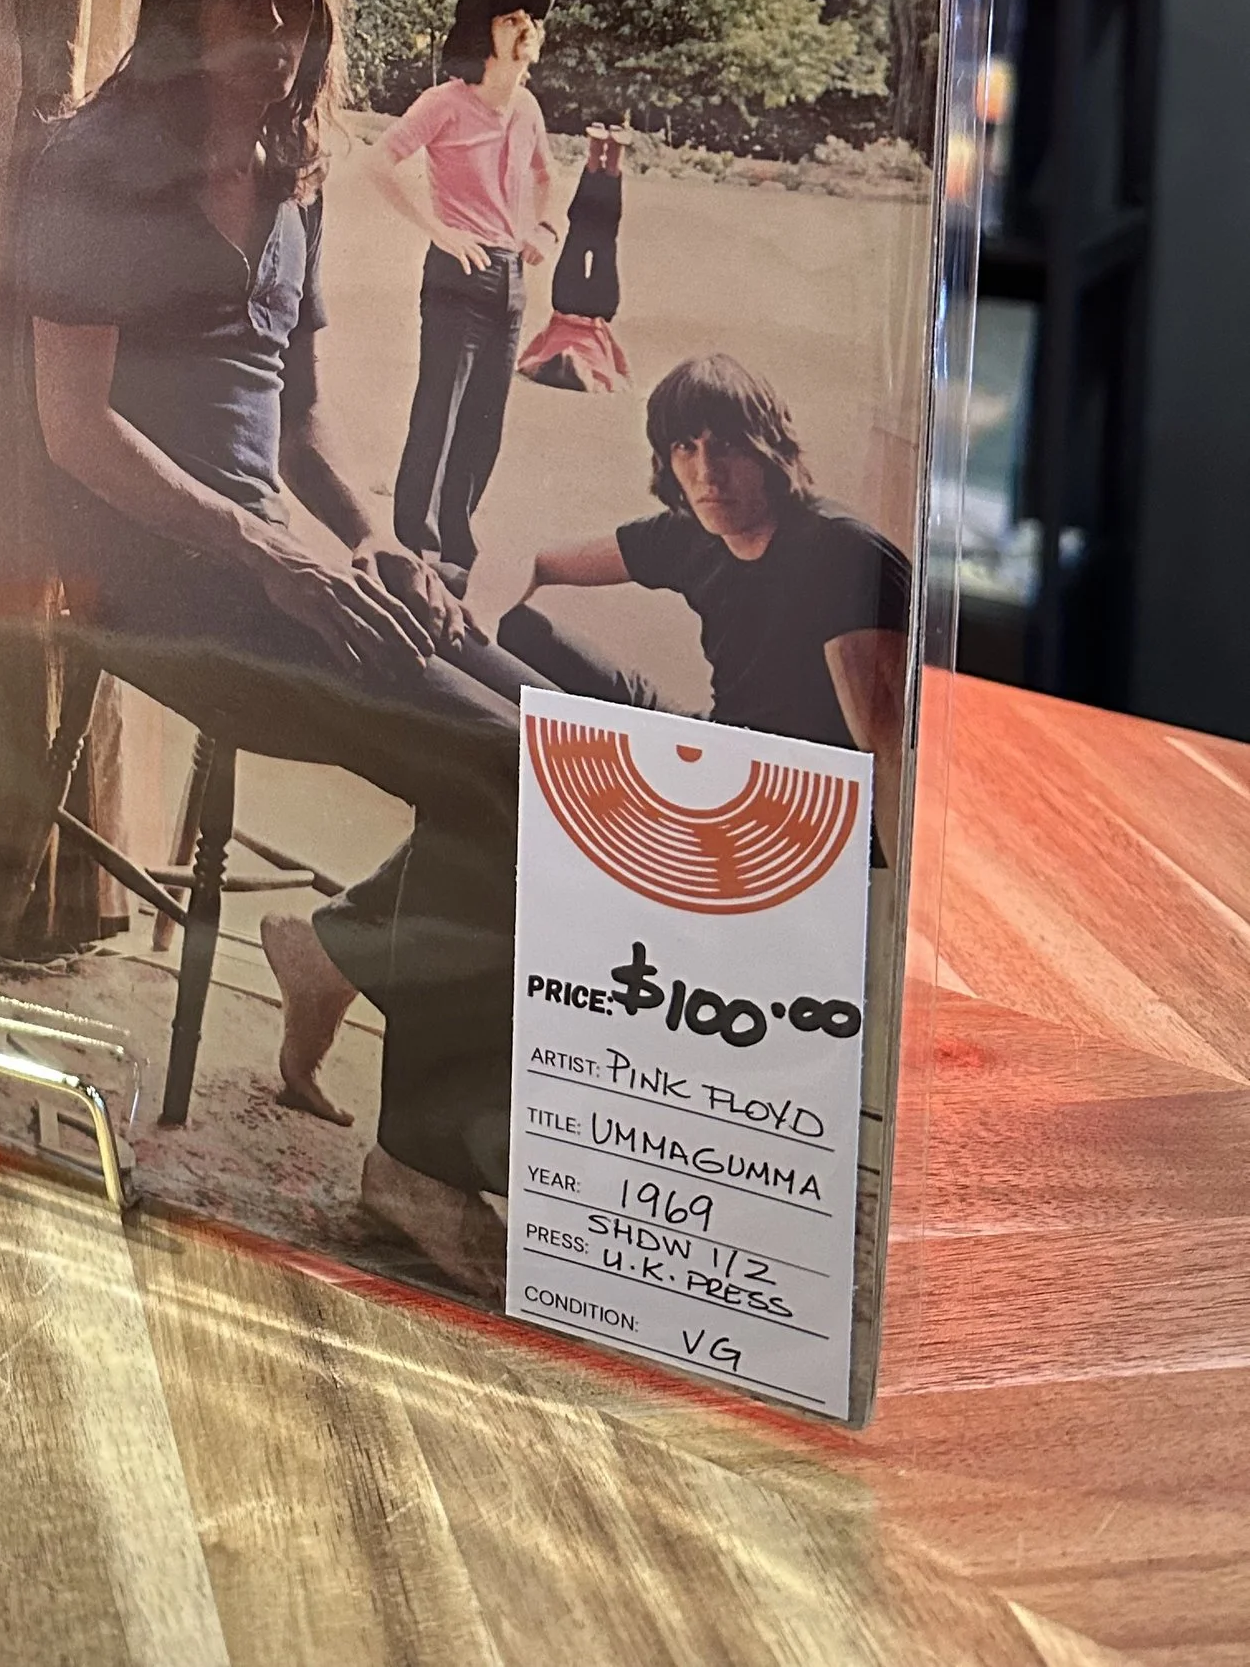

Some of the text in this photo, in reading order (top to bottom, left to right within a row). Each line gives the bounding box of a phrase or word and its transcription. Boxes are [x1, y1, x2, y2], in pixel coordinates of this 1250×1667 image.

[527, 974, 615, 1016] PRICE:
[530, 1046, 825, 1139] ARTIST: PINK FLOYD
[526, 1106, 821, 1201] TITLE: UMMAGUMMA
[527, 1164, 714, 1232] YEAR: 1969
[587, 1214, 692, 1260] SHDW
[525, 1222, 589, 1255] PRESS:
[686, 1270, 793, 1318] PRESS
[523, 1285, 742, 1372] CONDITION: VG
